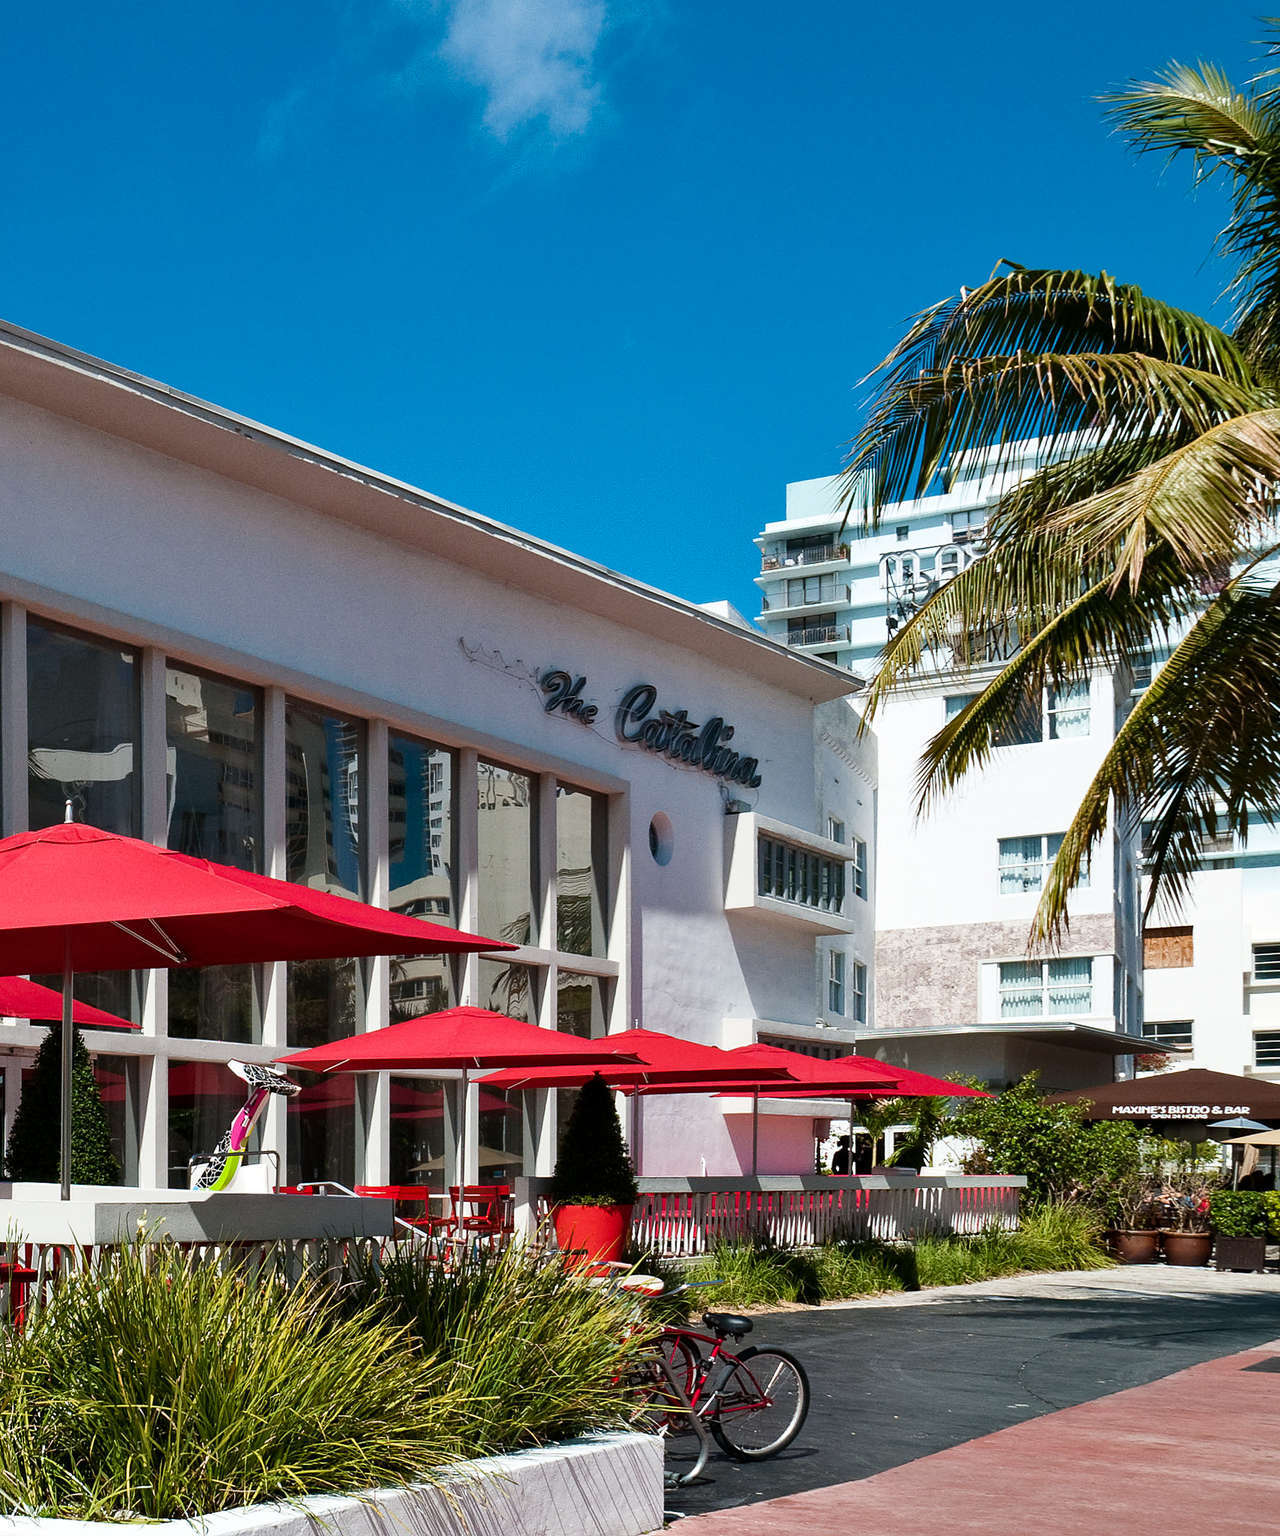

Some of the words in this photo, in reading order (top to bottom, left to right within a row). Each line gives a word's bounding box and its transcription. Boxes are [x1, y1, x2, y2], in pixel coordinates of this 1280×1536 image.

[540, 670, 599, 725] The
[614, 684, 762, 788] Catalina
[1112, 1105, 1167, 1115] MAXINE'S
[1168, 1105, 1210, 1115] BISTRO
[1211, 1105, 1223, 1115] &
[1224, 1105, 1251, 1115] BAR
